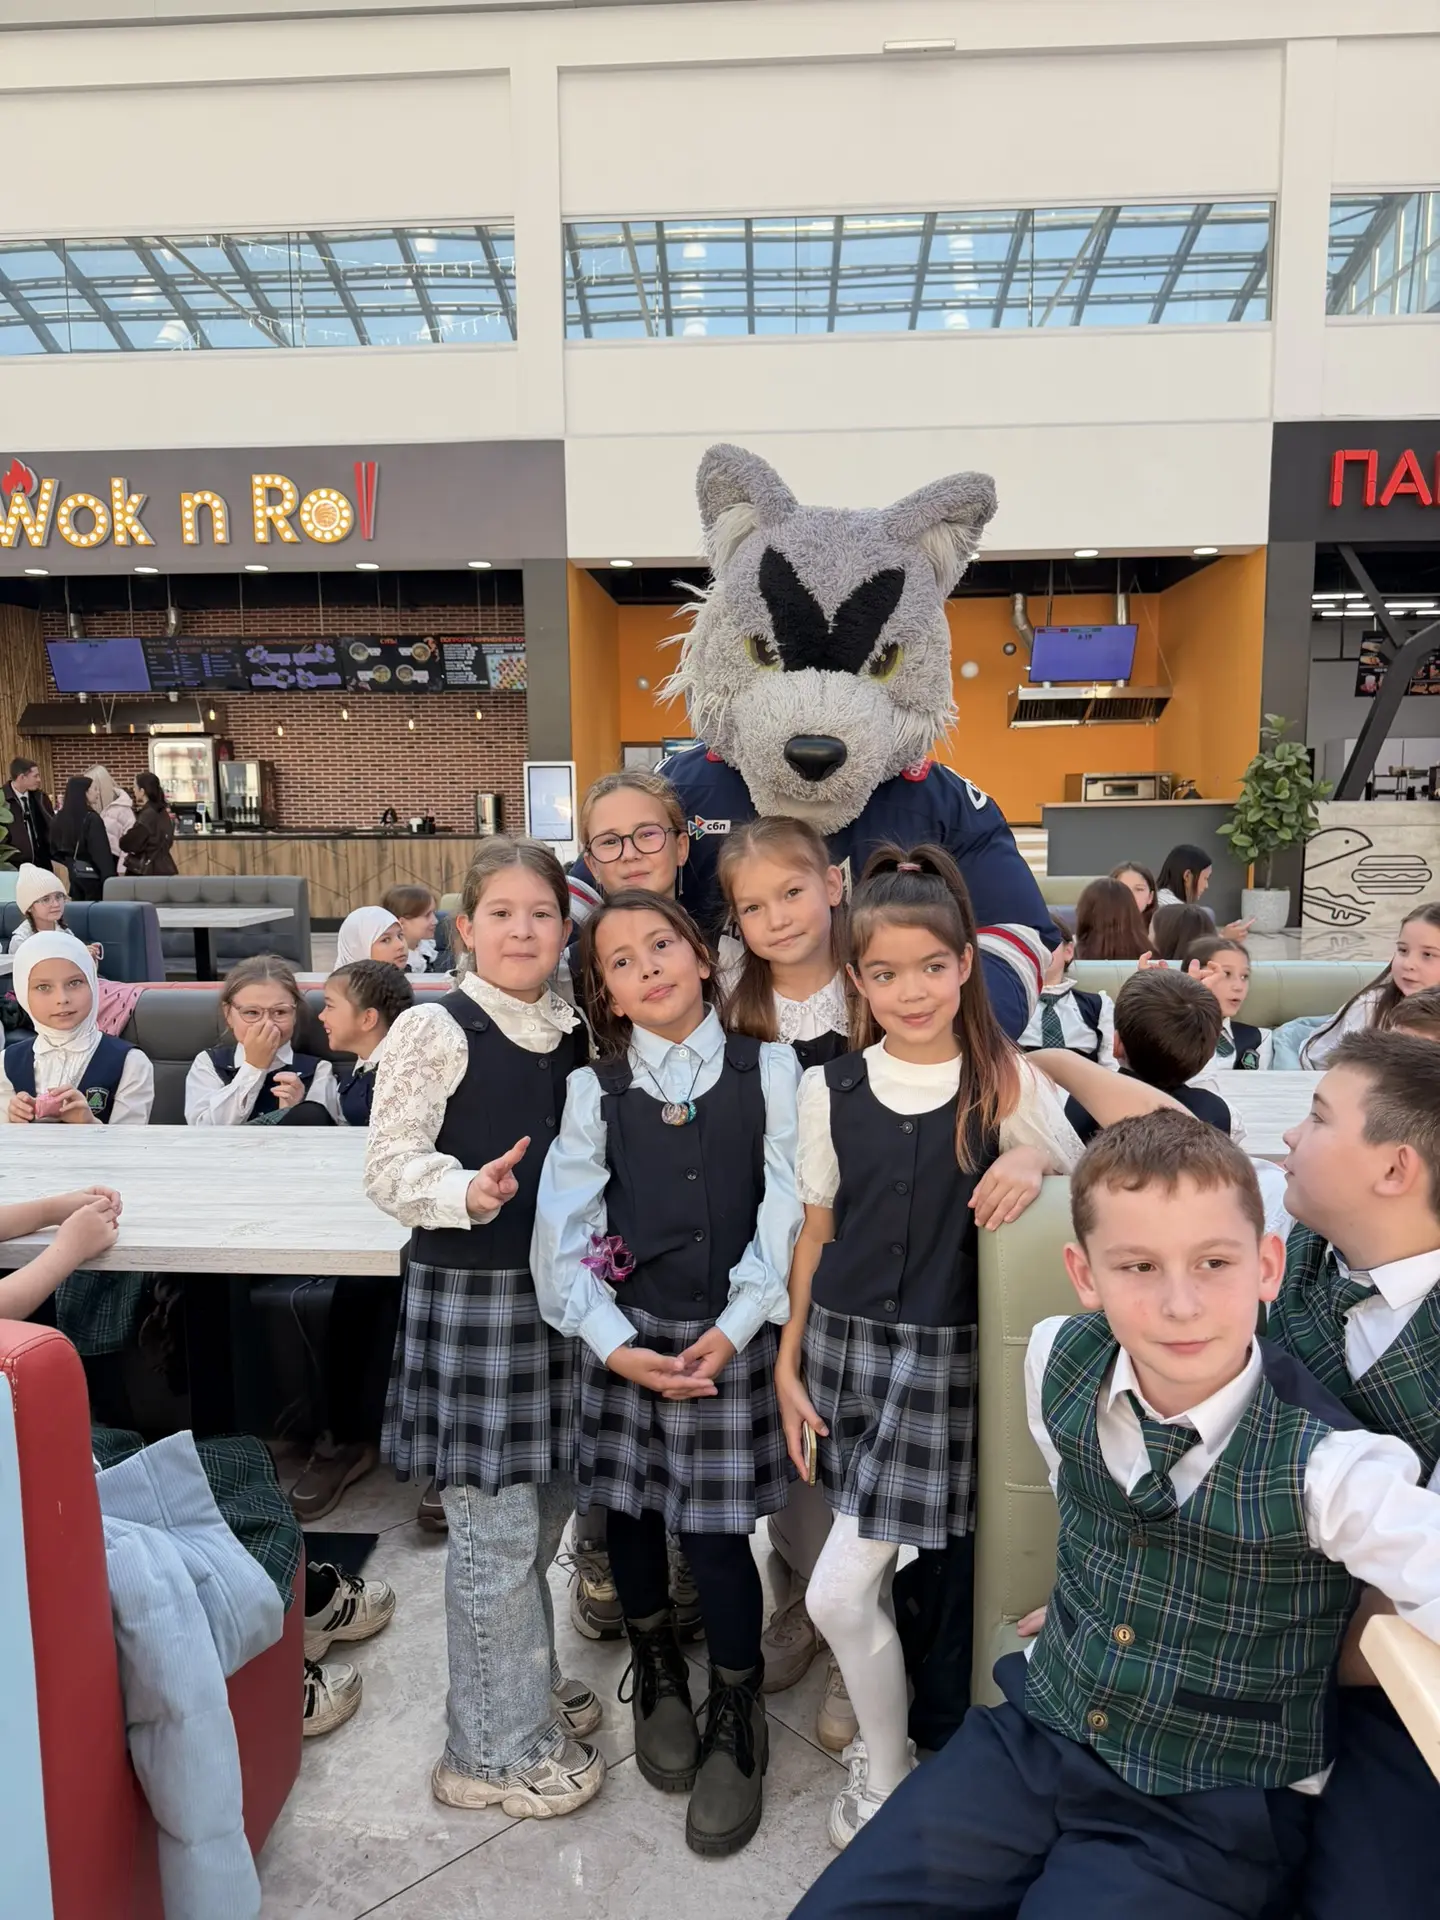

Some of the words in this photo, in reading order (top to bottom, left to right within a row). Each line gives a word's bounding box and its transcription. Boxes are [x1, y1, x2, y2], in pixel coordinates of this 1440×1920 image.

[1331, 449, 1440, 507] ПА
[0, 476, 156, 548] Wok
[181, 490, 231, 545] n
[707, 822, 726, 831] сбп
